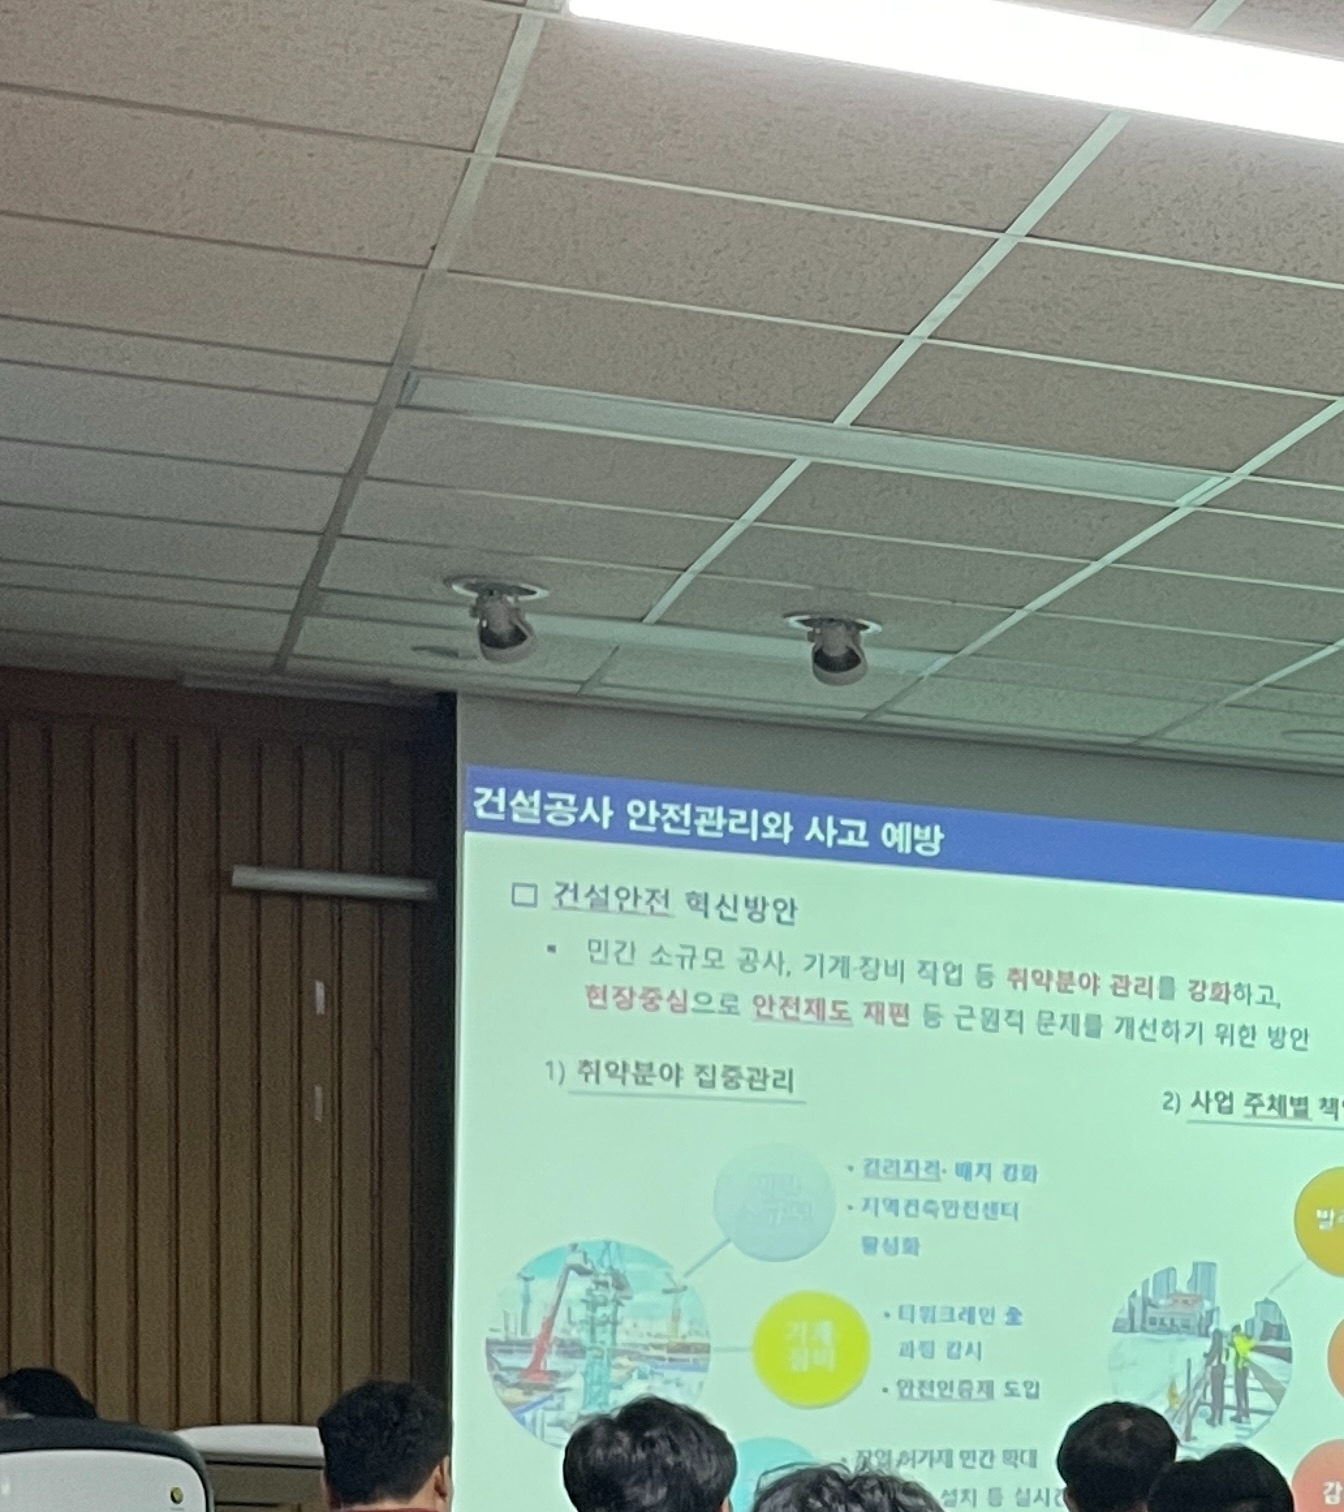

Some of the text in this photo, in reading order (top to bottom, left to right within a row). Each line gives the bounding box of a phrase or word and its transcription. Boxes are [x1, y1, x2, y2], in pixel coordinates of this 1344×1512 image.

[473, 785, 945, 858] 건설공사 안전관리와 사고 예방
[553, 881, 799, 928] 건설안전 혁신방안
[586, 936, 637, 967] 민간
[649, 942, 726, 972] 소규모
[736, 946, 792, 980] 공사,
[917, 958, 964, 989] 작업
[976, 963, 996, 990] 등
[1006, 967, 1100, 997] 취약분야
[1111, 974, 1176, 1000] 관리를
[1187, 979, 1282, 1009] 강화하고,
[585, 982, 1310, 1053] 현장중심으로 안전제도 재편 등 근원적 문제를 개선하기 위한 방안
[545, 1058, 796, 1095] 1) 취약분야 집중관리
[1162, 1090, 1182, 1115] 2)
[1190, 1092, 1235, 1116] 사업
[1243, 1094, 1312, 1121] 주체별
[1003, 1380, 1041, 1401] 도입
